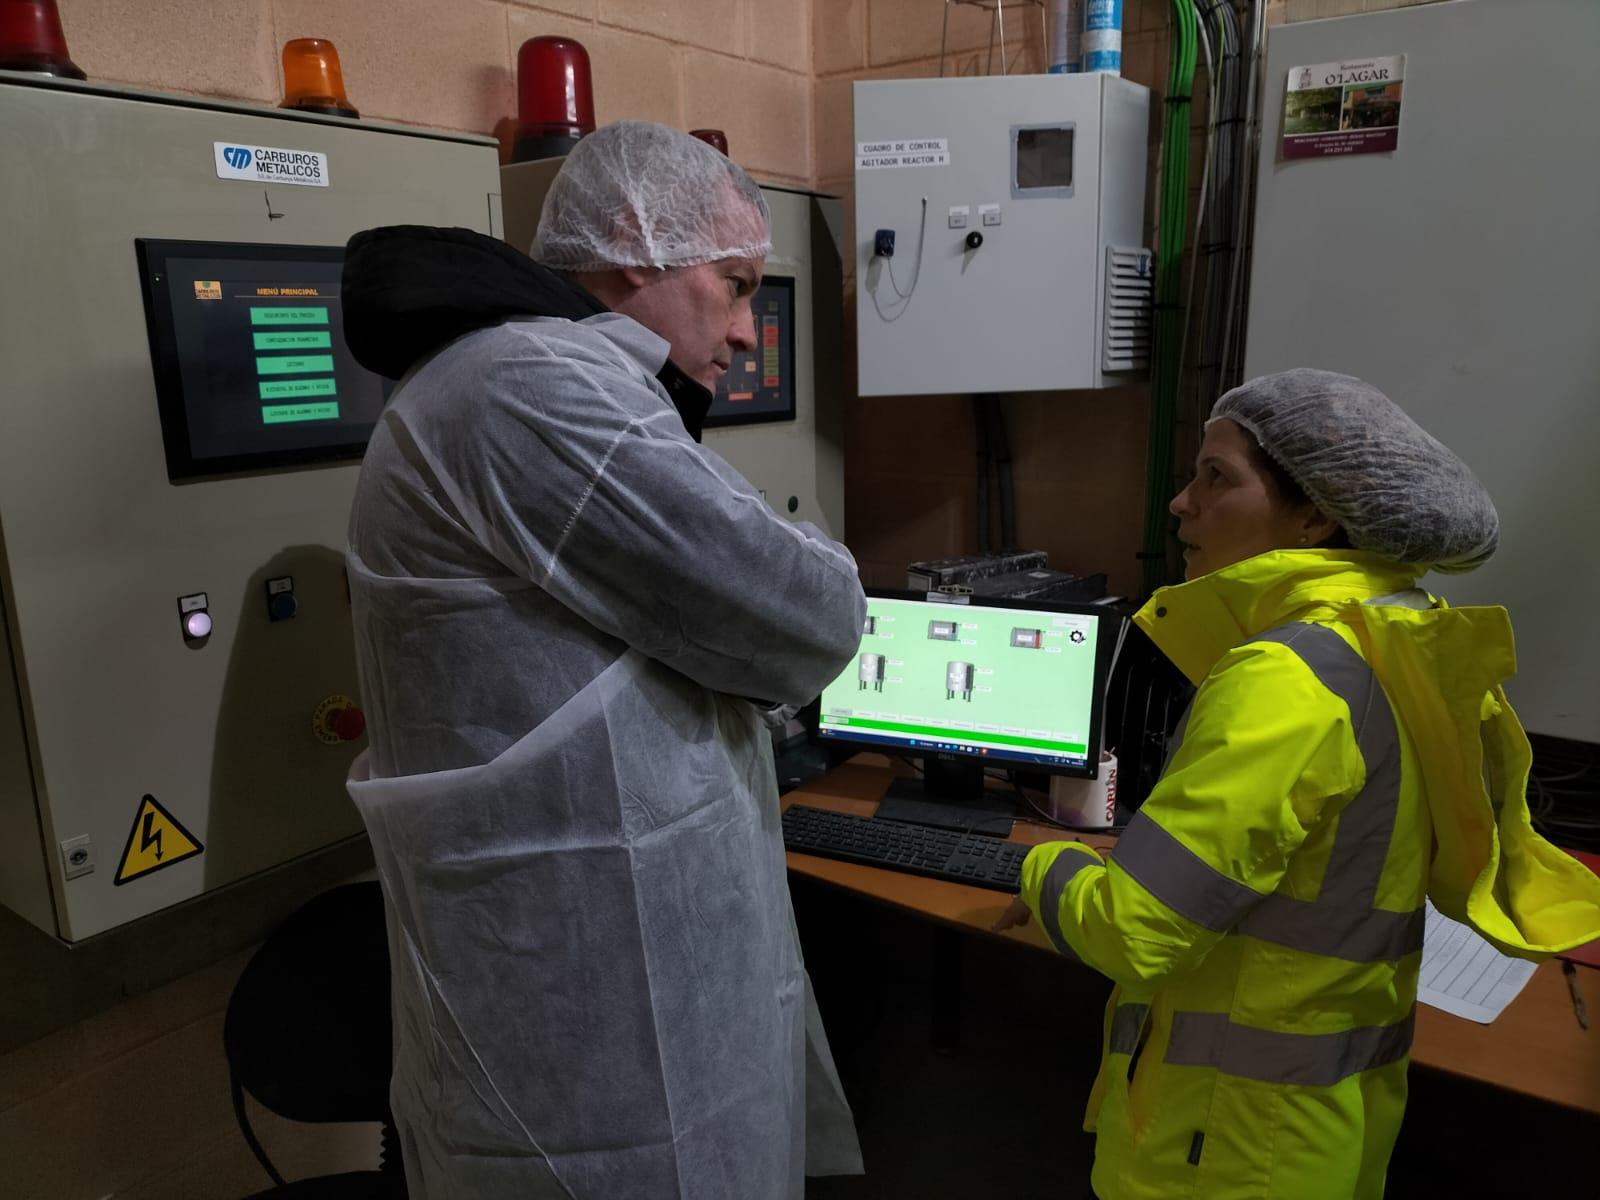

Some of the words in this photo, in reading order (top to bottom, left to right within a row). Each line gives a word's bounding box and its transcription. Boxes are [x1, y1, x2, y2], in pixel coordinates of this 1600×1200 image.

[863, 144, 892, 153] CUADRO
[895, 143, 905, 151] DE
[909, 142, 942, 151] CONTROL
[254, 149, 319, 166] CARBUROS
[861, 157, 898, 167] AGITADOR
[902, 155, 935, 165] REACTOR
[256, 162, 321, 177] METALICOS
[280, 288, 319, 296] PRINCIPAL
